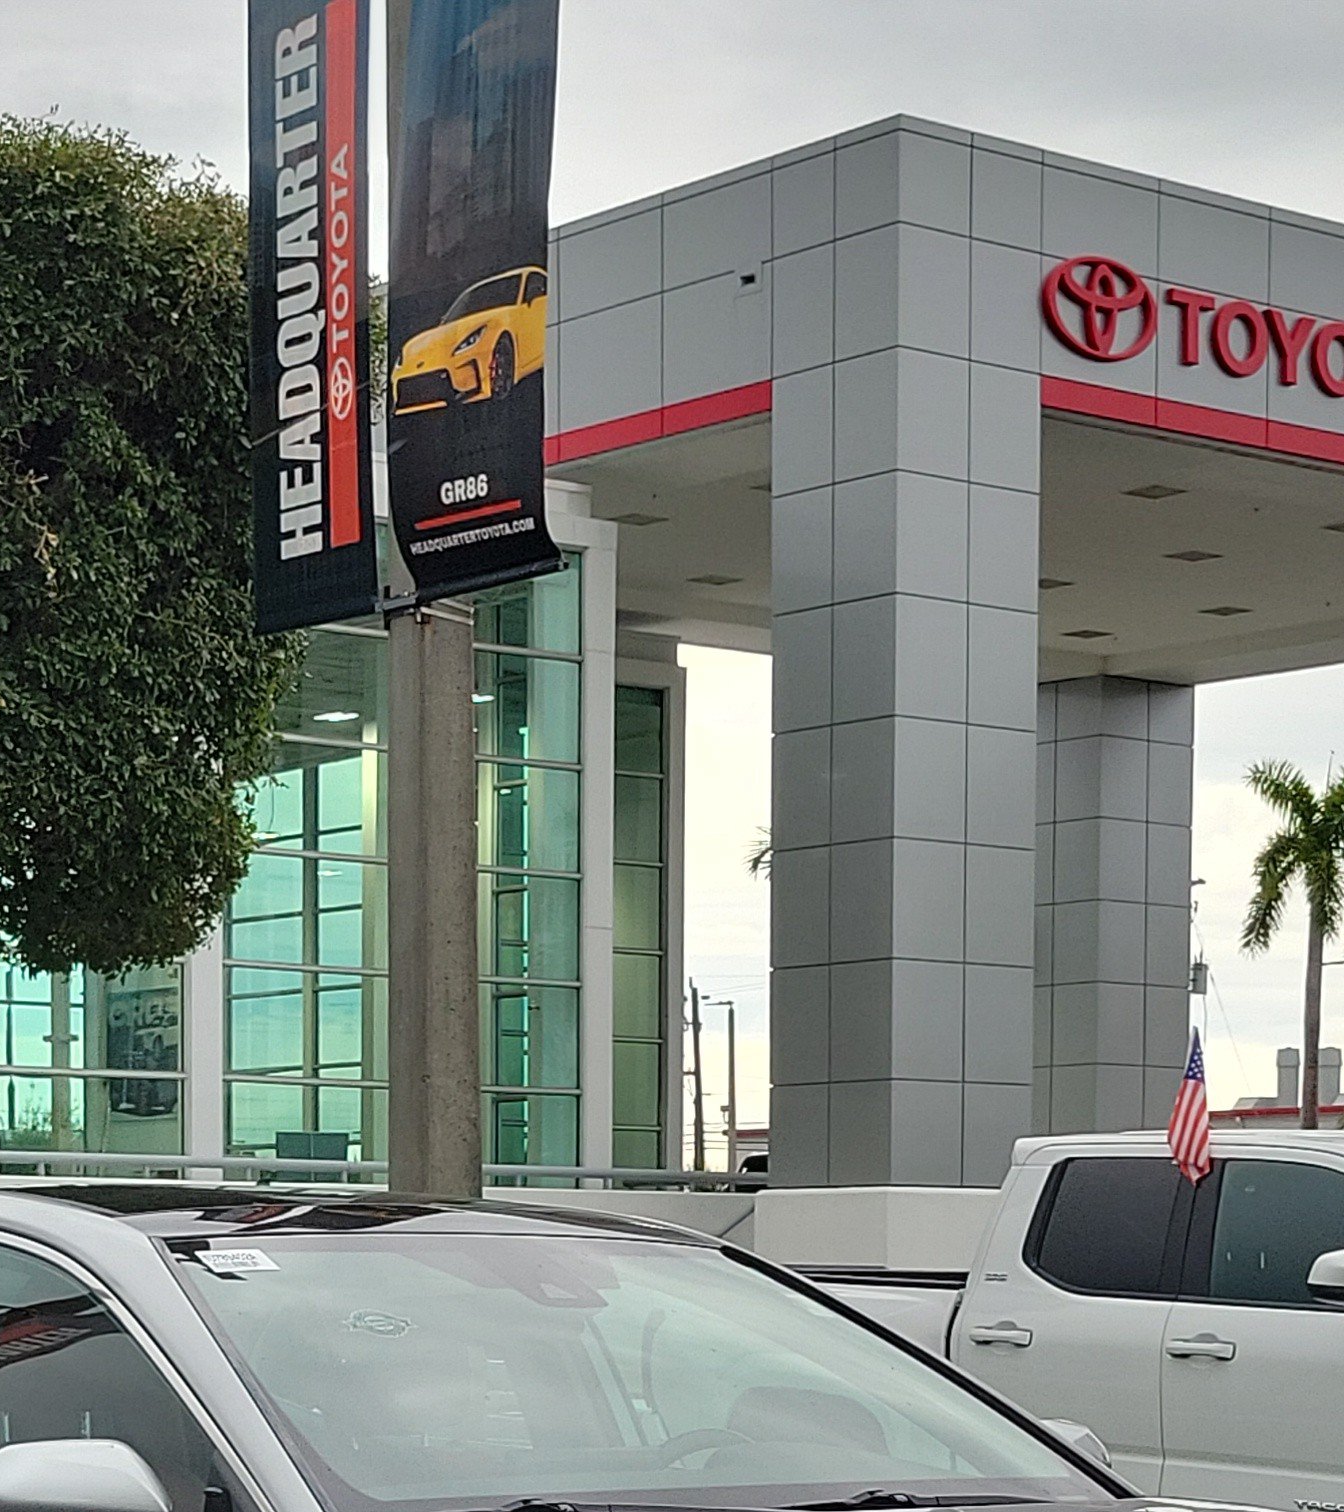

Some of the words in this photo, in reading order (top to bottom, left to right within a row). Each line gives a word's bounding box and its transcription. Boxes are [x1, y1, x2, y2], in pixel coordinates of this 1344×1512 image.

[275, 14, 324, 559] HEADQUARTER
[330, 143, 351, 353] TOYOTA
[409, 516, 536, 556] HEADQUARTERTOYOTA.COM
[439, 473, 489, 505] GR86
